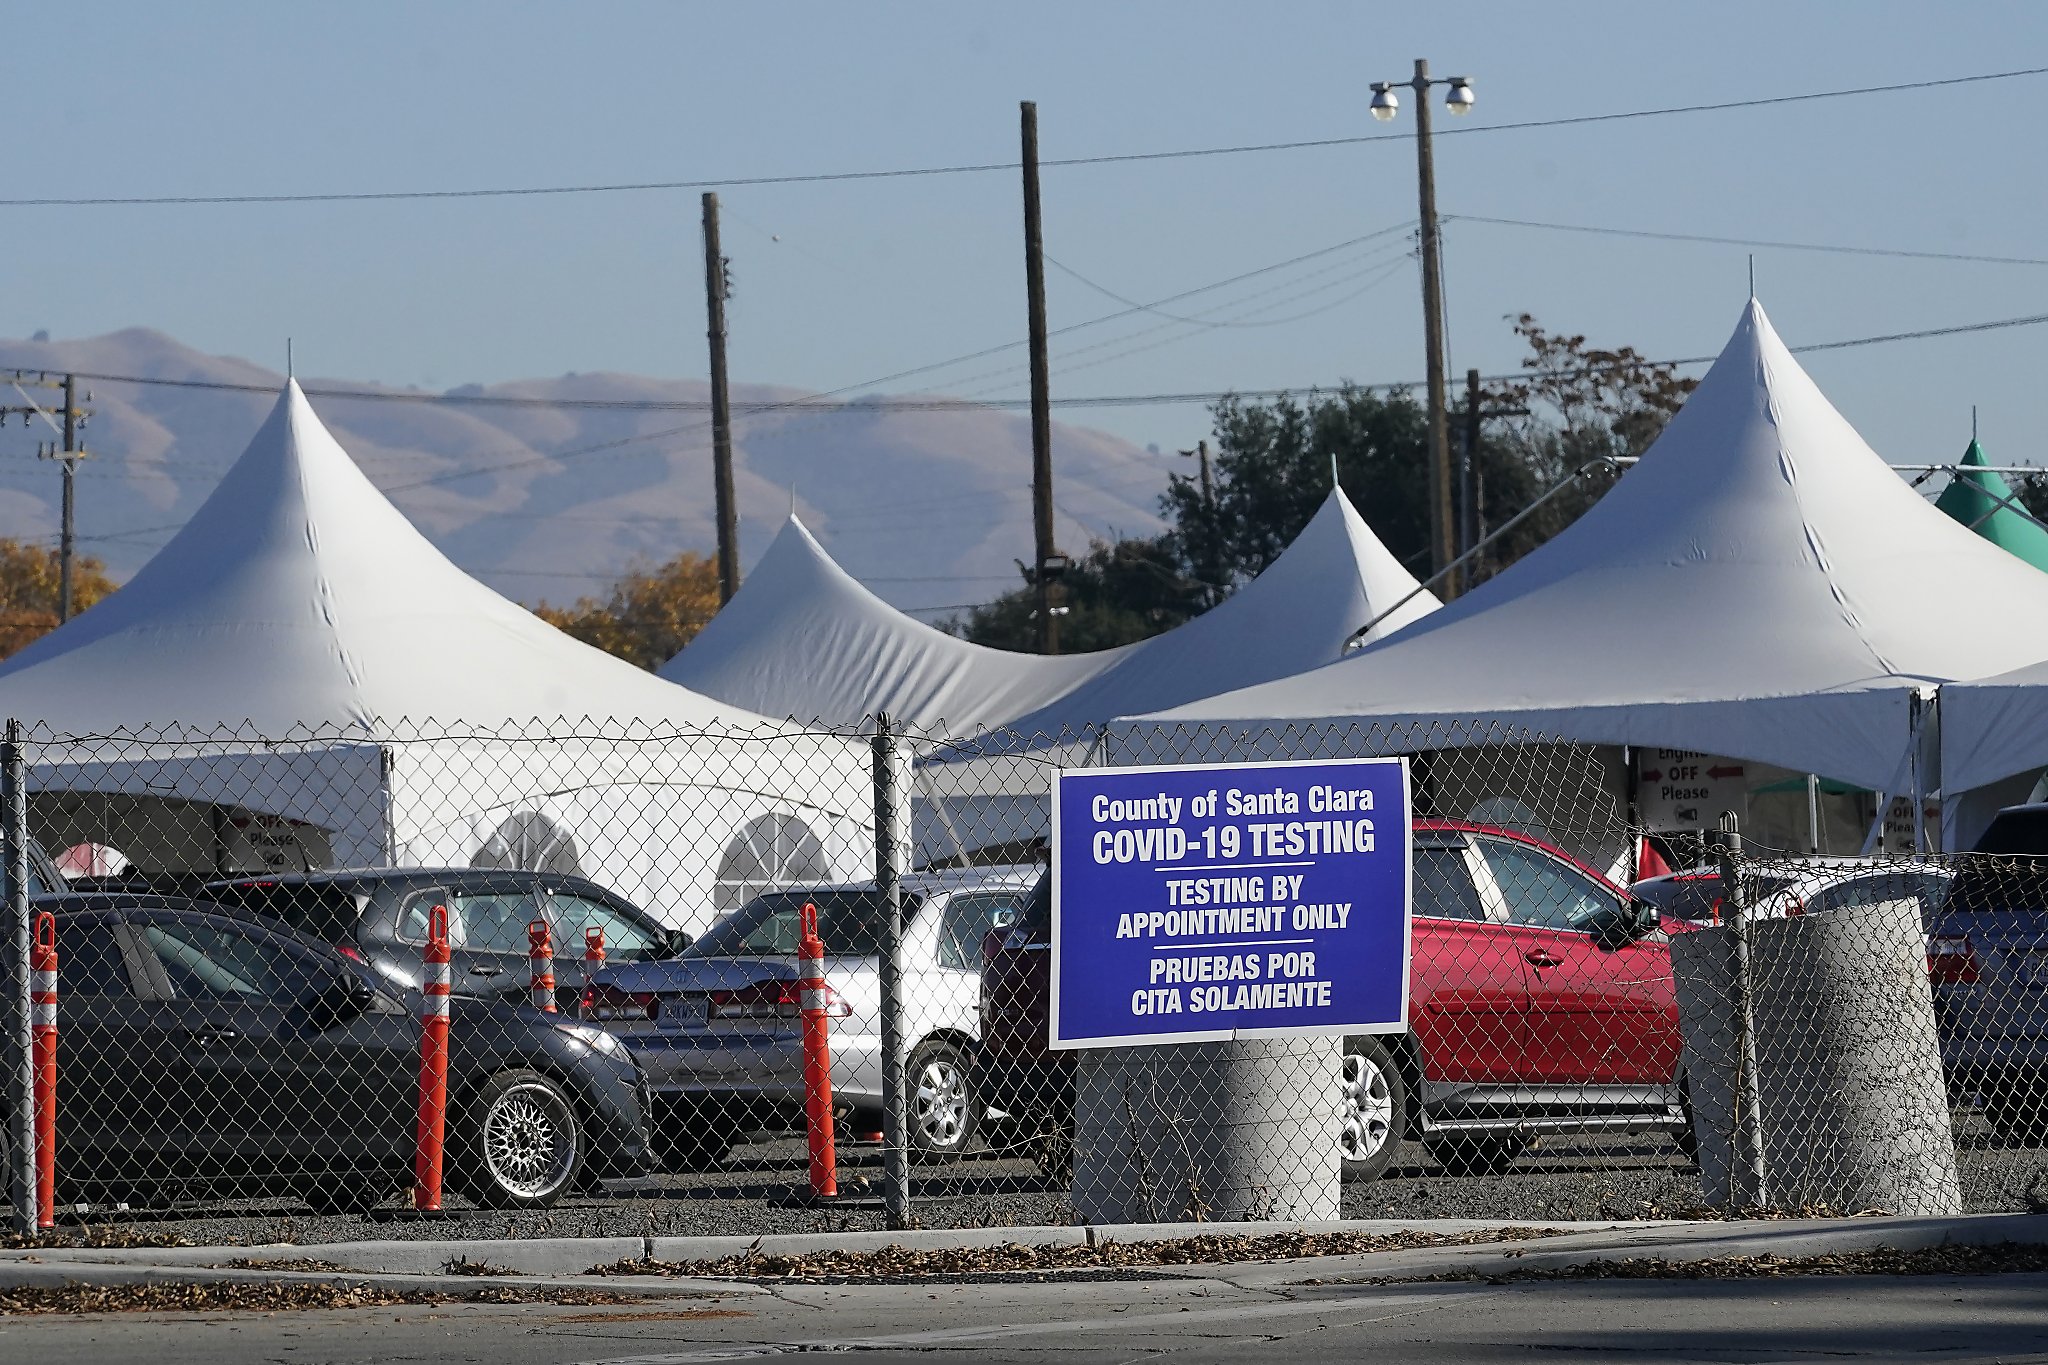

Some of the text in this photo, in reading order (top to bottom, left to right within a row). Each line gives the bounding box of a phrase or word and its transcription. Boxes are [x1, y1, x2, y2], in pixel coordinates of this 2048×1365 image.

[1669, 765, 1698, 780] OFF
[1092, 785, 1374, 825] County of Santa Clara
[1661, 786, 1708, 800] Please
[250, 831, 294, 846] Please
[1092, 818, 1375, 865] COVID-19 TESTING
[1166, 874, 1304, 906] TESTING BY
[1115, 902, 1352, 939] APPOINTMENT ONLY
[1149, 951, 1316, 985] PRUEBAS POR
[1131, 980, 1332, 1016] CITA SOLAMENTE
